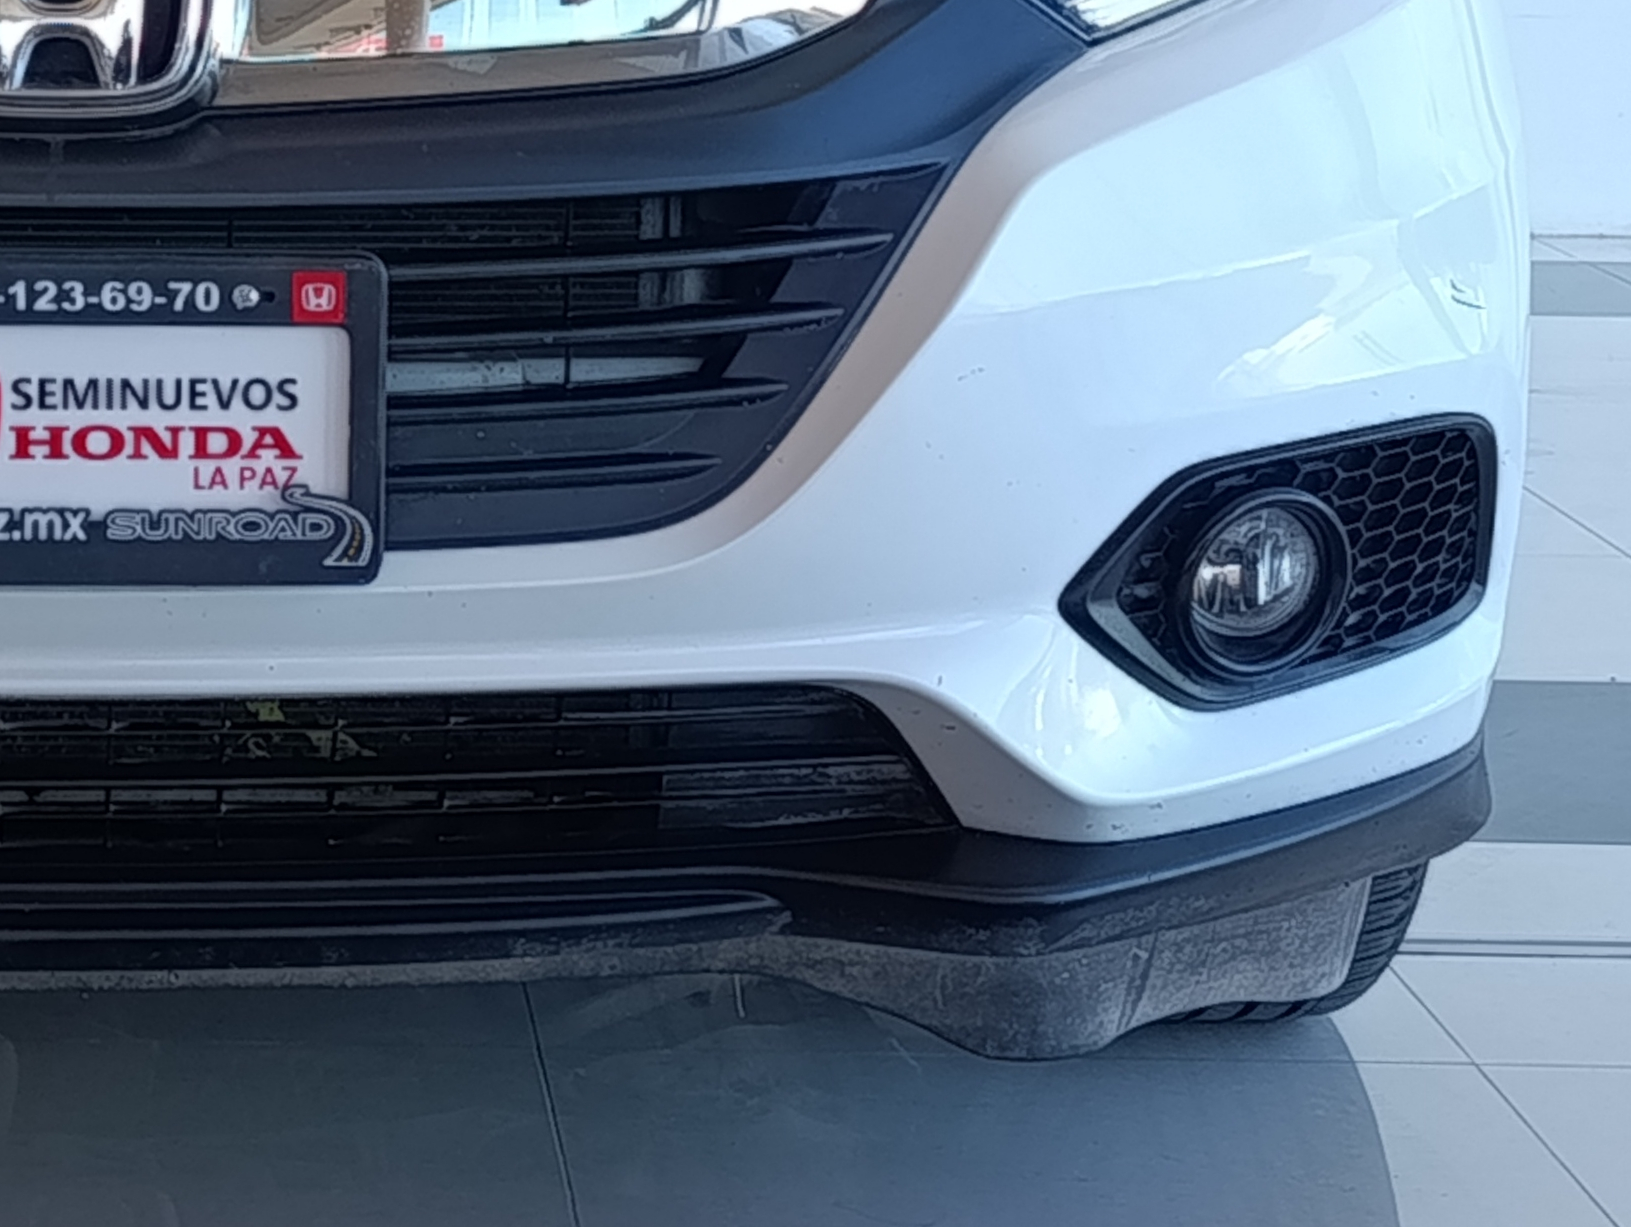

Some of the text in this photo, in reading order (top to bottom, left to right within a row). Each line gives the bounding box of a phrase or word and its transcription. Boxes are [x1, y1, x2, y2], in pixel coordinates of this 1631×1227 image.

[10, 377, 299, 411] SEMINUEVOS
[8, 424, 304, 461] HONDA
[193, 466, 299, 491] LA PAZ
[106, 511, 336, 542] SUNROAD
